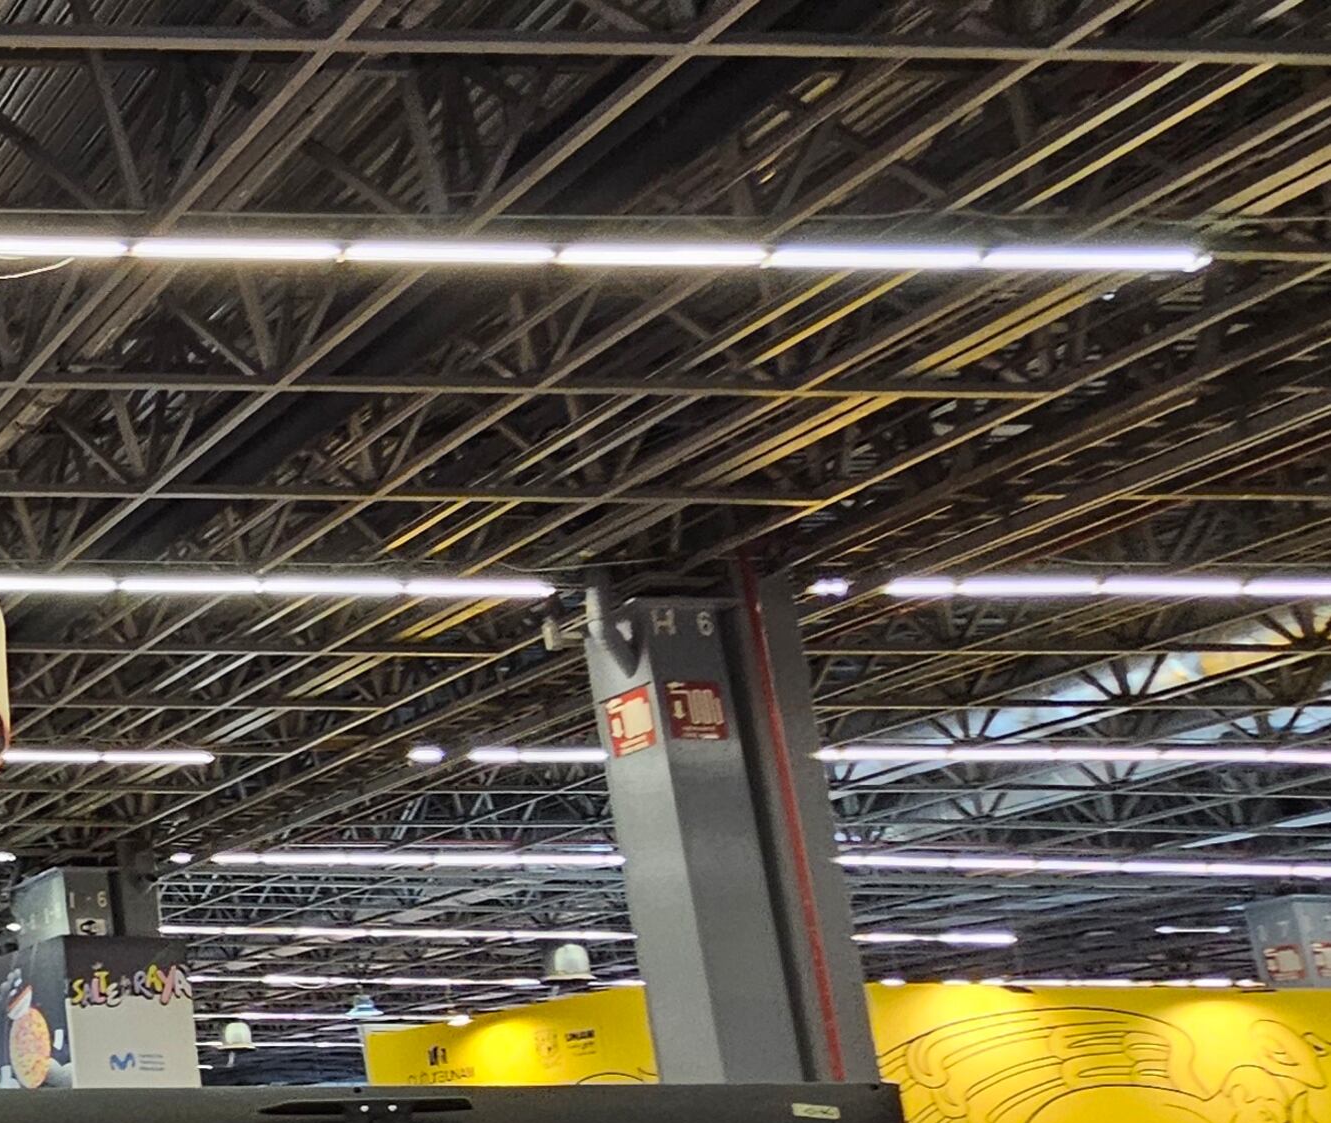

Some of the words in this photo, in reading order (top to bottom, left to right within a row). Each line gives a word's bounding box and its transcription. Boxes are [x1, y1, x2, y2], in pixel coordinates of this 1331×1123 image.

[651, 608, 677, 635] H
[696, 611, 715, 636] 6
[97, 890, 107, 907] 6
